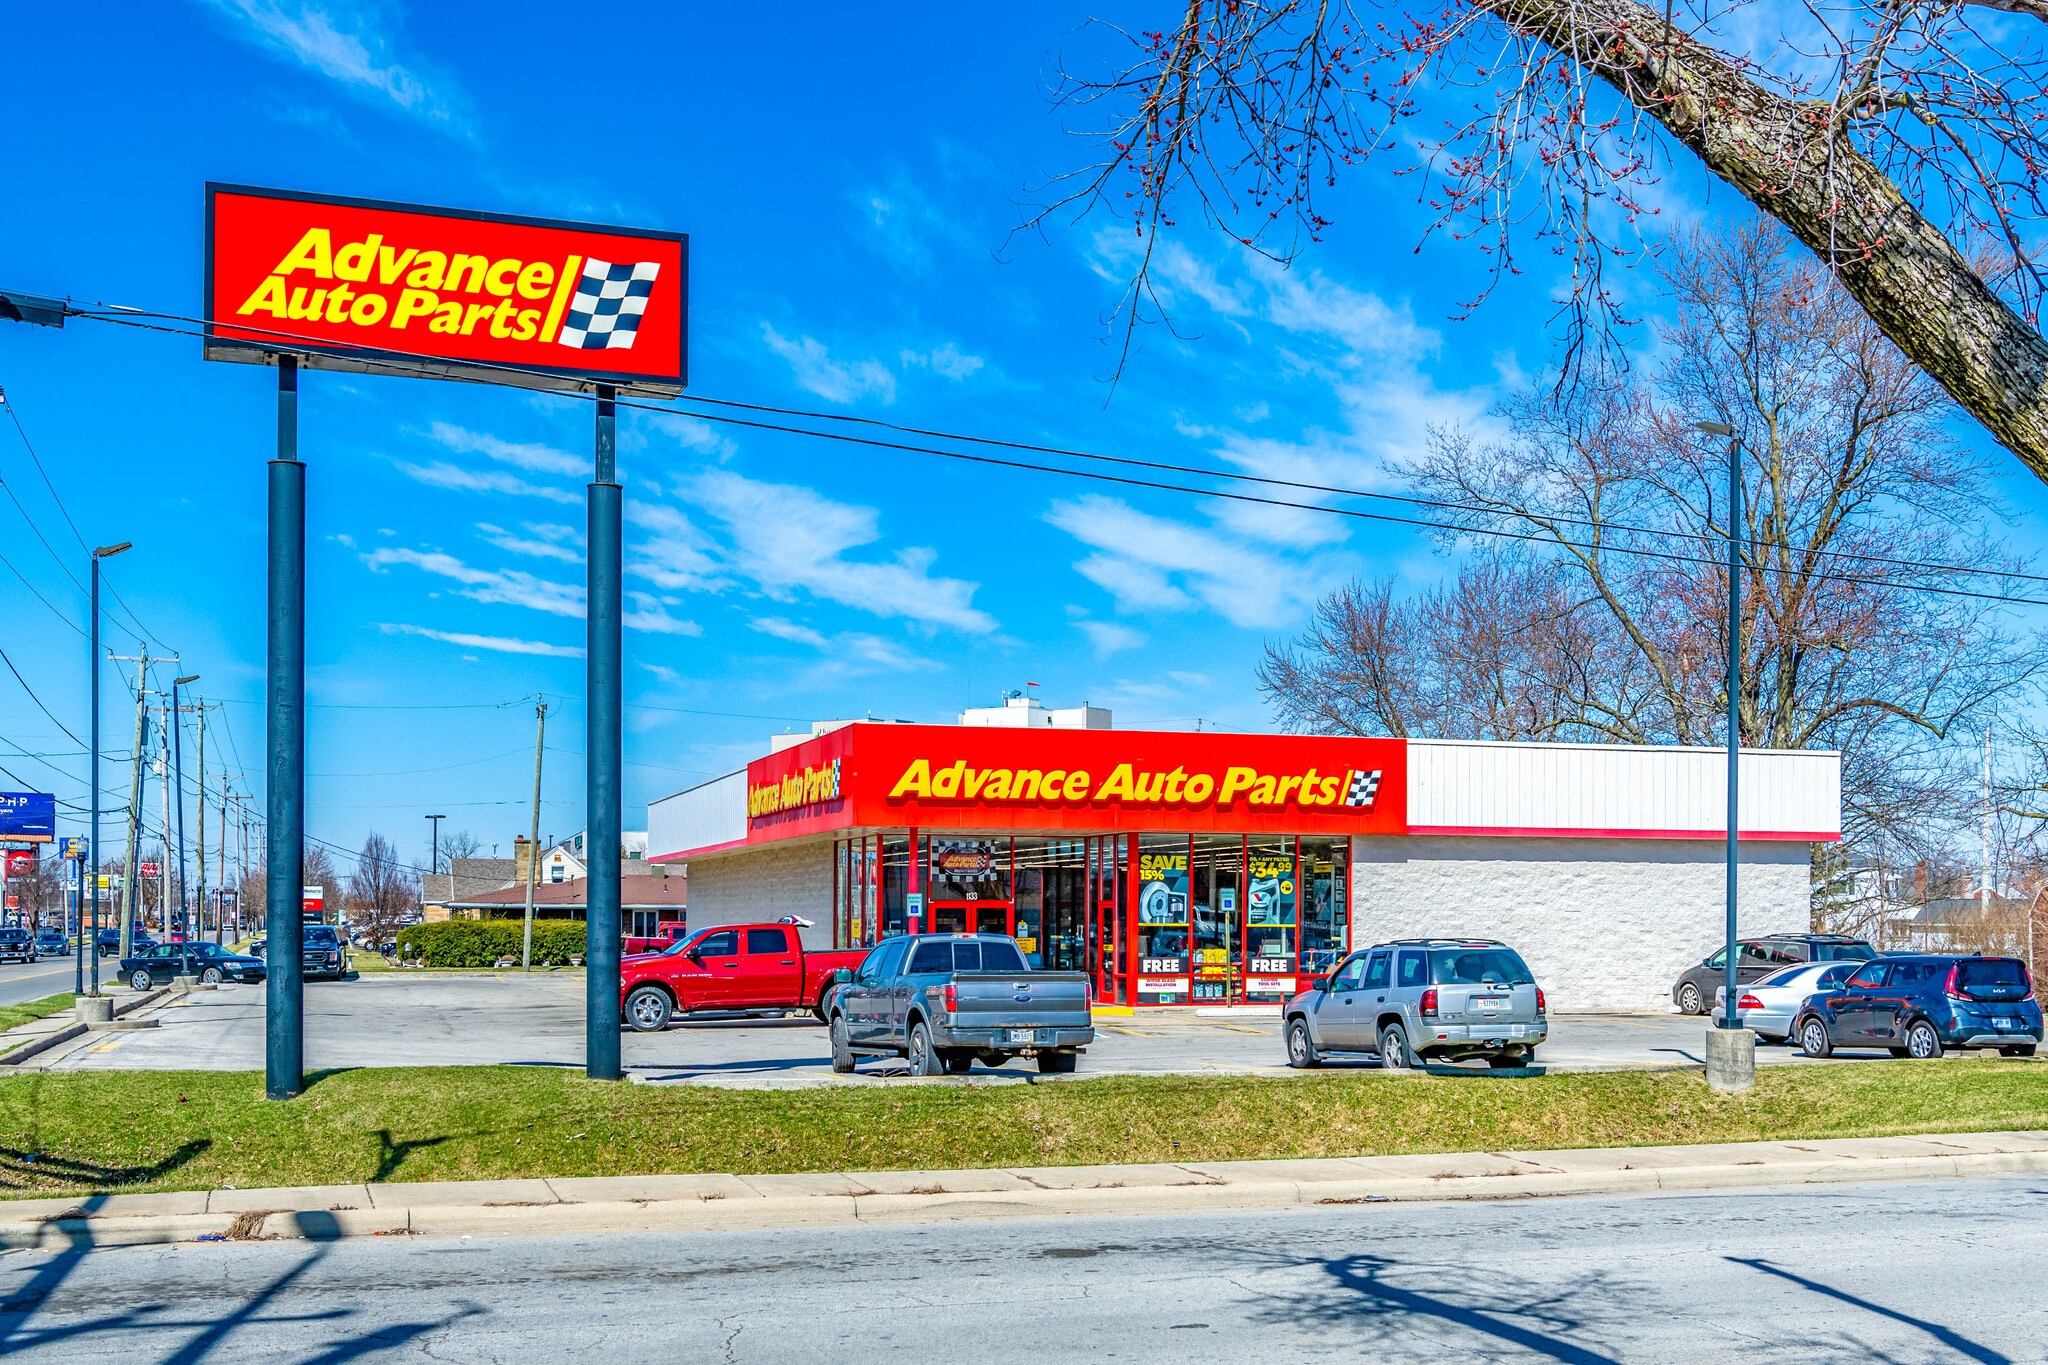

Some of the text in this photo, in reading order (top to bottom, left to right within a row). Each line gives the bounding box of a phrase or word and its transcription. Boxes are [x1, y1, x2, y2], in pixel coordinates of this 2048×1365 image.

[271, 227, 555, 299] Advance
[236, 275, 542, 341] Auto Parts
[780, 769, 803, 810] Auto
[803, 761, 832, 804] Parts
[888, 758, 1340, 806] Advance Auto Parts
[1140, 854, 1188, 870] SAVE
[1139, 869, 1165, 880] 15%
[966, 892, 978, 900] 1133
[1143, 959, 1180, 973] FREE
[1251, 959, 1288, 973] FREE
